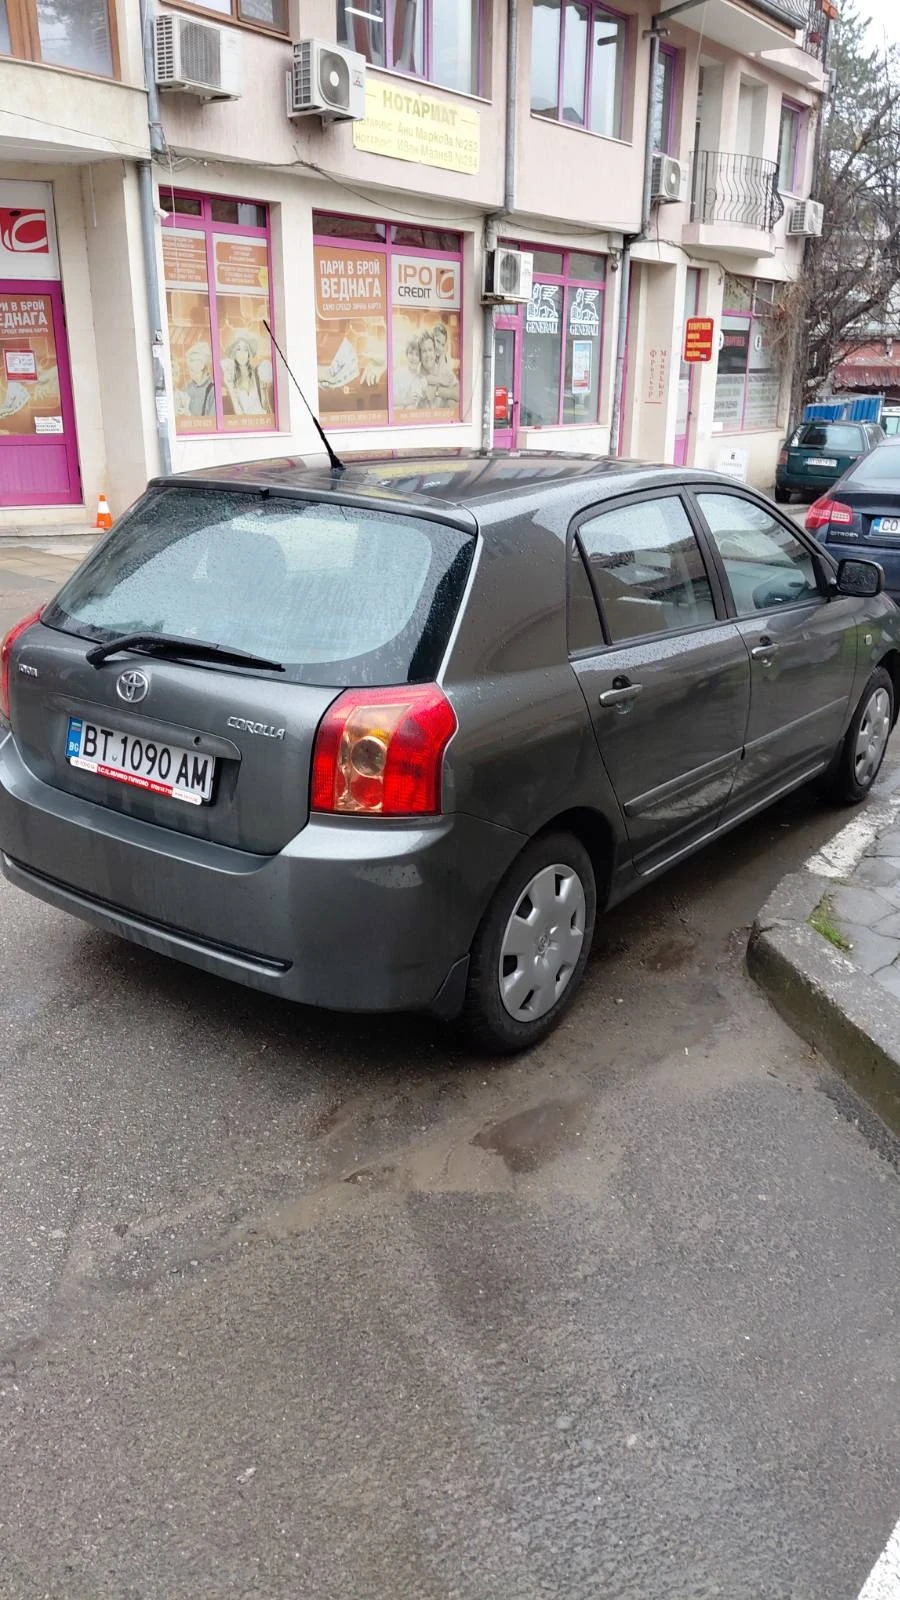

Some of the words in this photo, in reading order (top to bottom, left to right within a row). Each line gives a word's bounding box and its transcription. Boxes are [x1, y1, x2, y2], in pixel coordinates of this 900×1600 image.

[383, 89, 457, 126] НОТАРИАТ
[320, 260, 345, 275] ПАРИ
[347, 261, 354, 275] В
[357, 259, 380, 275] БРОЙ
[398, 263, 432, 286] IPO
[321, 277, 381, 301] ВЕДНАГА
[398, 285, 432, 299] CREDIT
[11, 301, 18, 311] В
[20, 299, 45, 311] БРОЙ
[526, 321, 558, 334] GENERALI
[570, 323, 599, 337] GENERALI
[227, 715, 286, 740] COROLLA
[68, 741, 79, 752] BG
[83, 725, 113, 761] BT
[120, 736, 171, 779] 1090
[175, 753, 208, 793] AM
